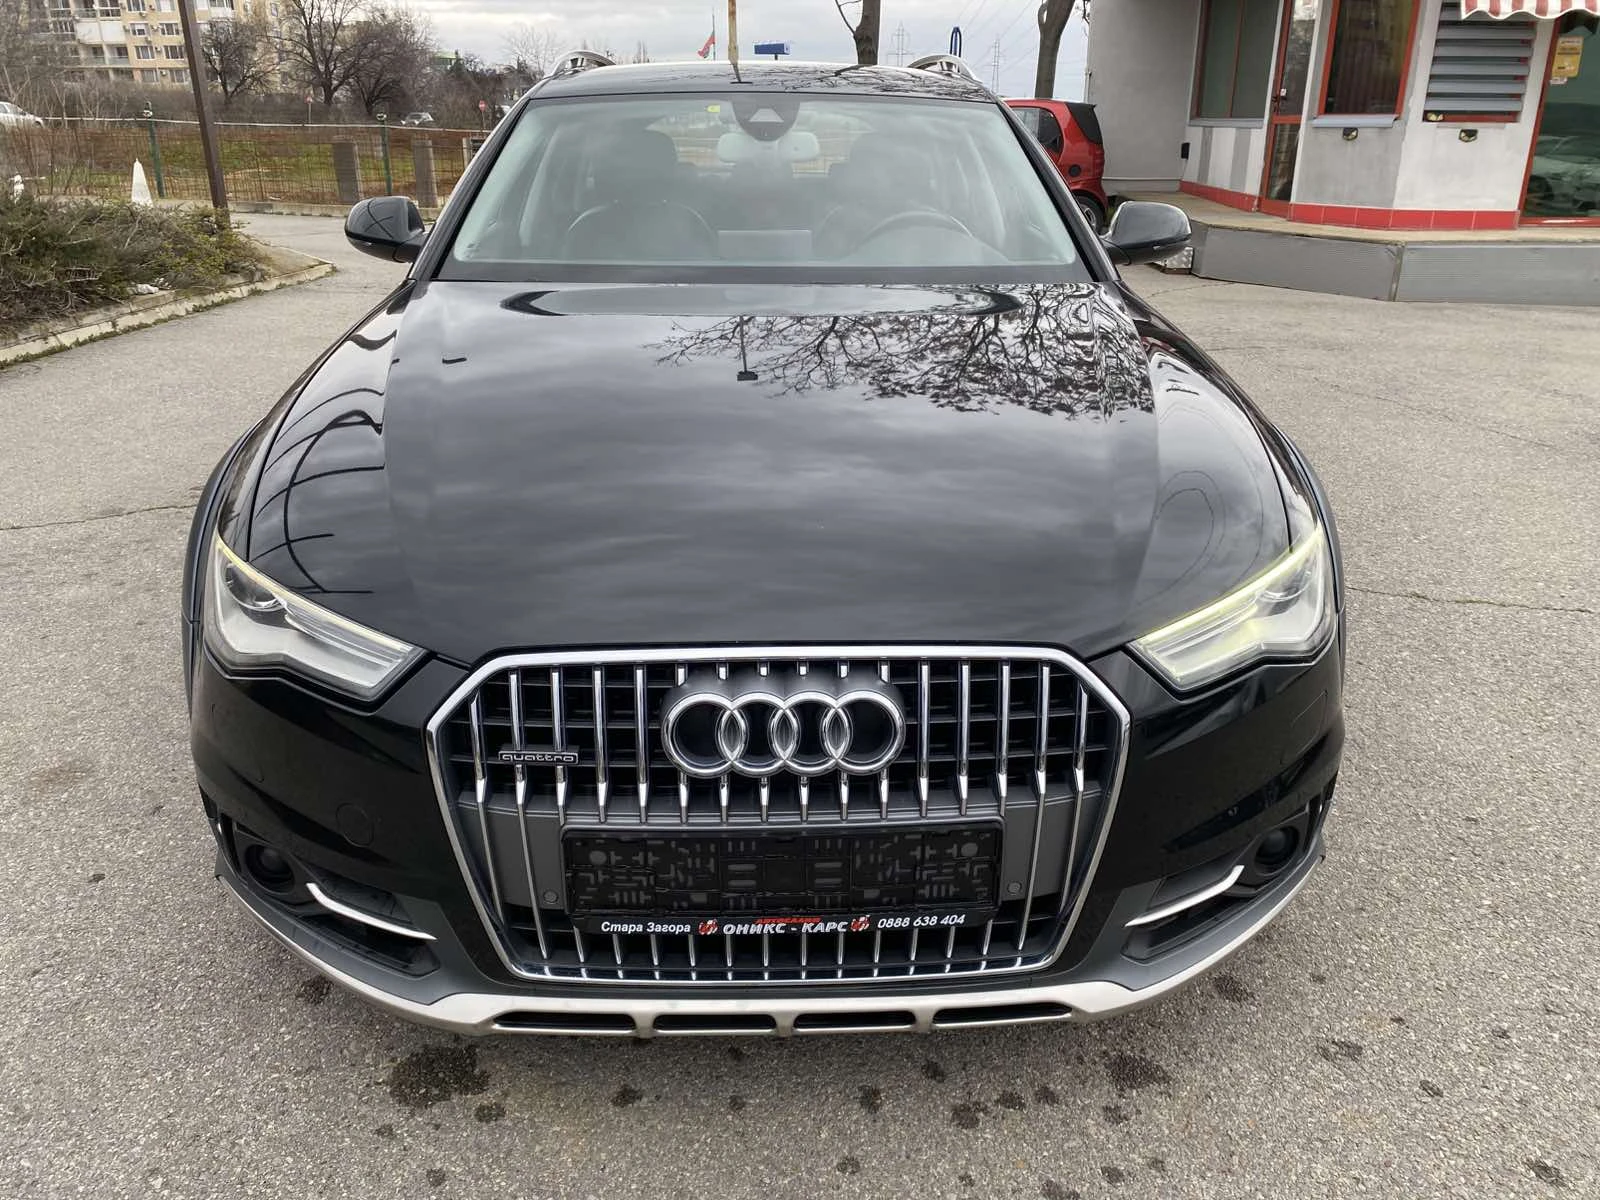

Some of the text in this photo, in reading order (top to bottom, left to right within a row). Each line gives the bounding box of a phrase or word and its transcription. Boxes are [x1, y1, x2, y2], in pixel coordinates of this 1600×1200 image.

[502, 754, 574, 762] quattro
[601, 921, 691, 935] Стара Загора
[722, 922, 787, 935] ОНИКС
[801, 921, 848, 933] КАРС
[877, 914, 966, 928] 0888 638 404
